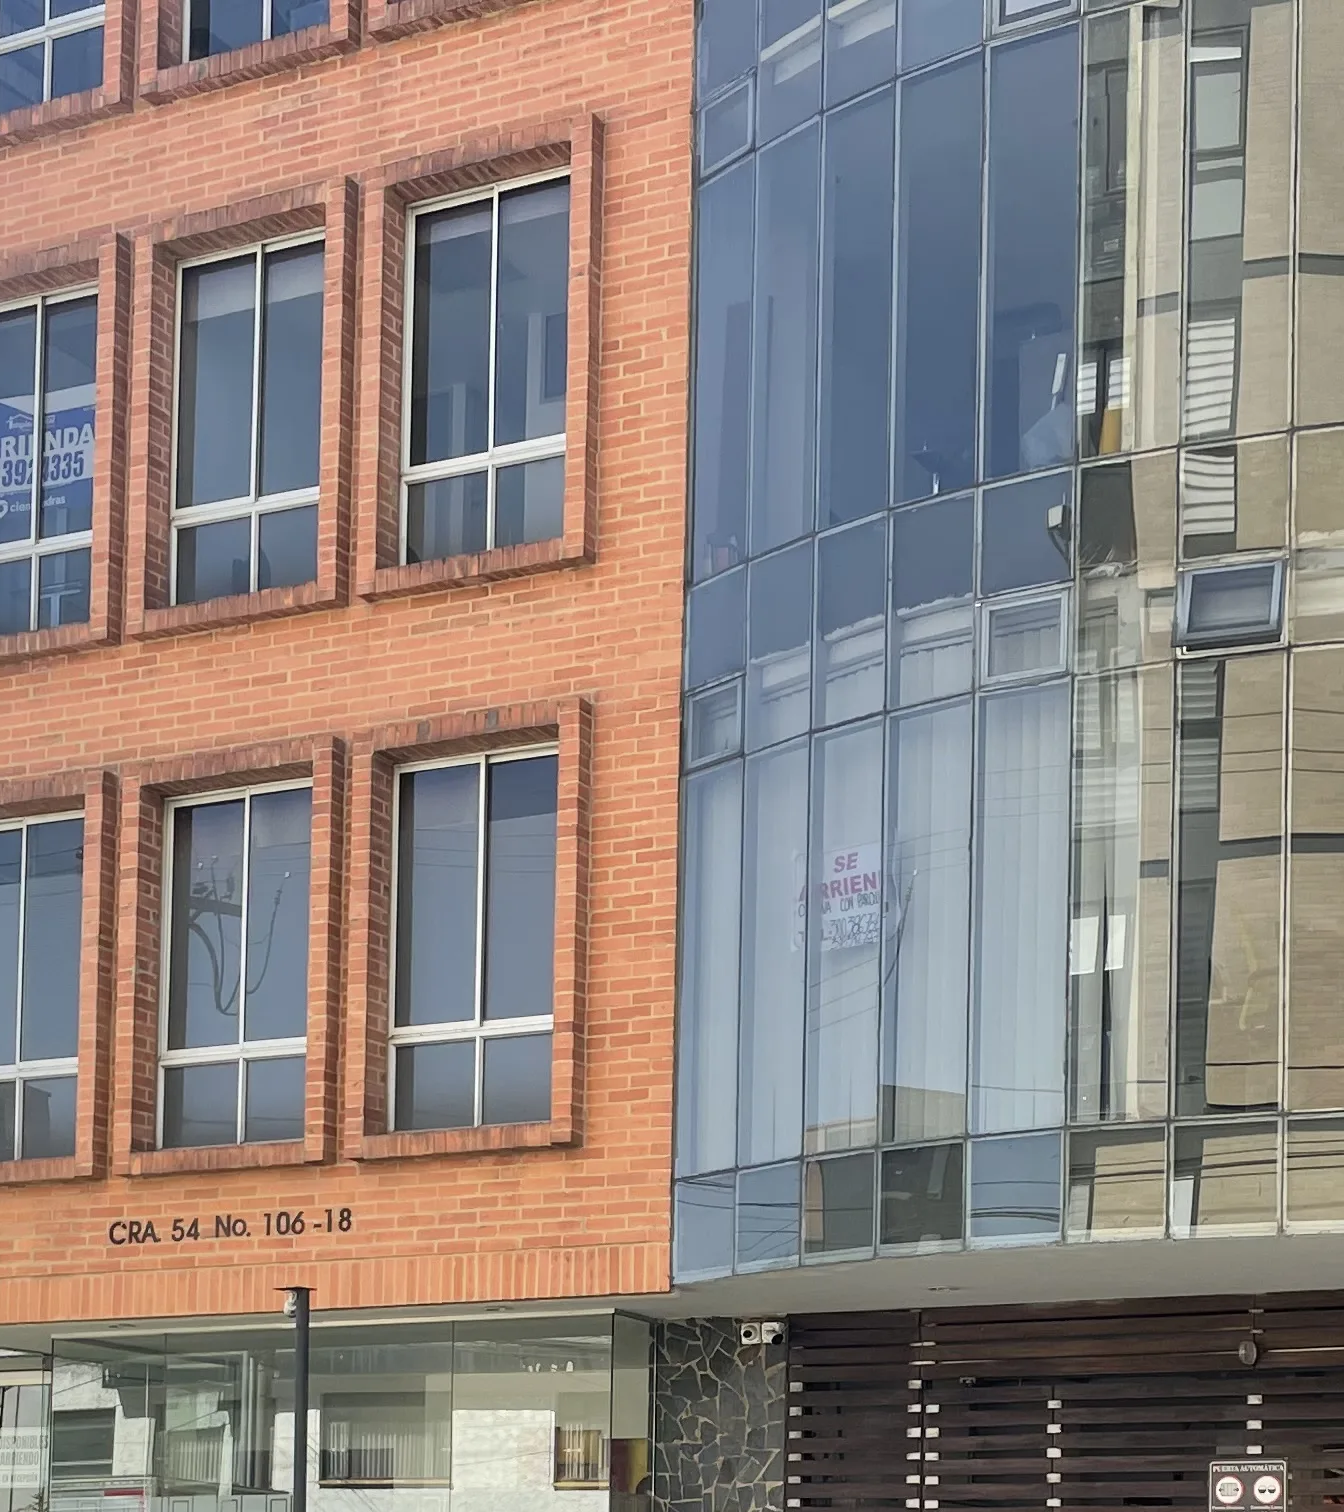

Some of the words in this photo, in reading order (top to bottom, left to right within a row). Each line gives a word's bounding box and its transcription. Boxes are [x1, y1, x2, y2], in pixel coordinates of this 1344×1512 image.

[833, 852, 859, 874] SE
[171, 1217, 200, 1242] 54
[215, 1214, 251, 1238] No.
[263, 1211, 306, 1236] 106
